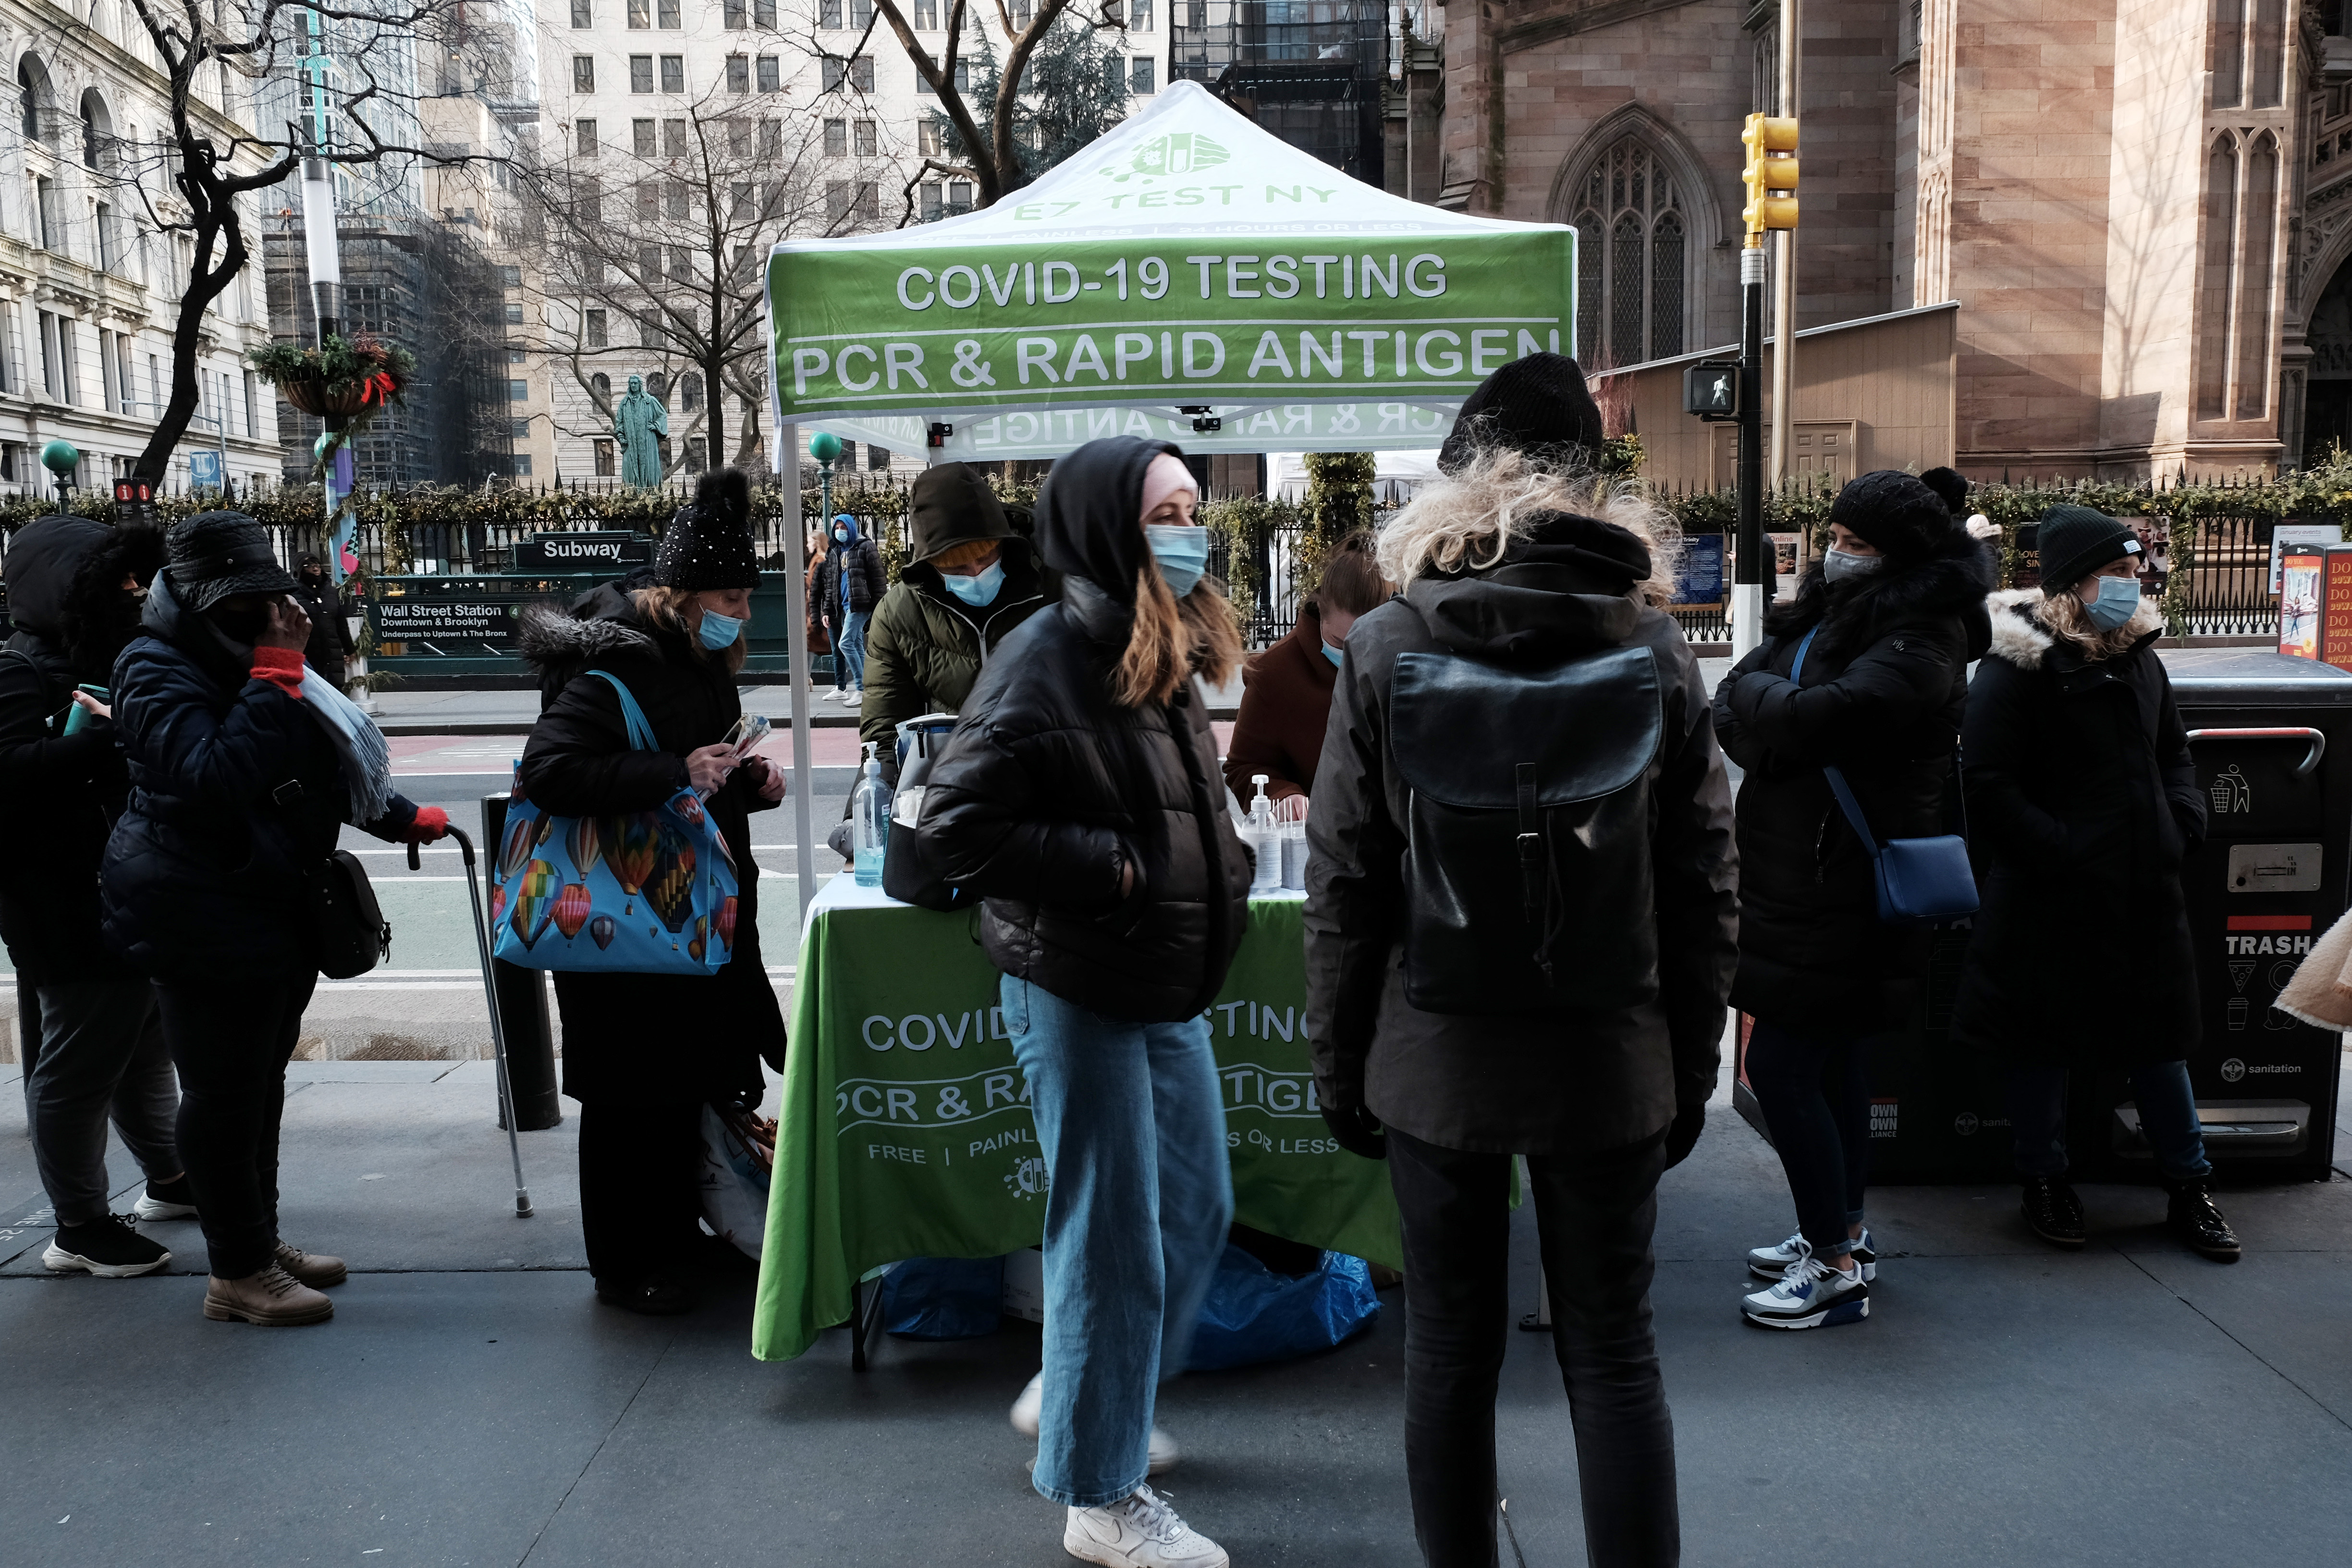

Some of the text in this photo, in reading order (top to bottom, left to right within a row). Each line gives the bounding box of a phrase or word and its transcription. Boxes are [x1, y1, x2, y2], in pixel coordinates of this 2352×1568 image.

[1101, 185, 1244, 209] TEST
[1266, 184, 1340, 203] NY
[1215, 223, 1306, 233] HOURS
[1313, 223, 1349, 232] OR
[1359, 222, 1423, 232] LESS
[896, 253, 1446, 311] COVID-19 TESTING
[793, 342, 929, 395] PCR
[950, 339, 996, 387] &
[1016, 331, 1225, 385] RAPID
[544, 541, 621, 559] Subway
[2332, 563, 2351, 573] DO
[2330, 588, 2350, 600] DO
[380, 605, 518, 616] Wall Street Station 4
[381, 618, 432, 626] Downtown
[445, 617, 488, 627] Brooklyn
[2328, 615, 2348, 626] DO
[432, 630, 460, 638] Uptown
[2328, 642, 2346, 653] DO
[2226, 936, 2310, 955] TRASH
[2249, 1065, 2301, 1073] sanitation
[936, 1086, 971, 1119] &
[1870, 1104, 1898, 1117] OWN
[1870, 1117, 1897, 1130] OWN
[869, 1144, 926, 1164] FREE
[969, 1128, 1038, 1157] PAINL
[1248, 1129, 1272, 1153] OR
[1280, 1139, 1339, 1154] LESS
